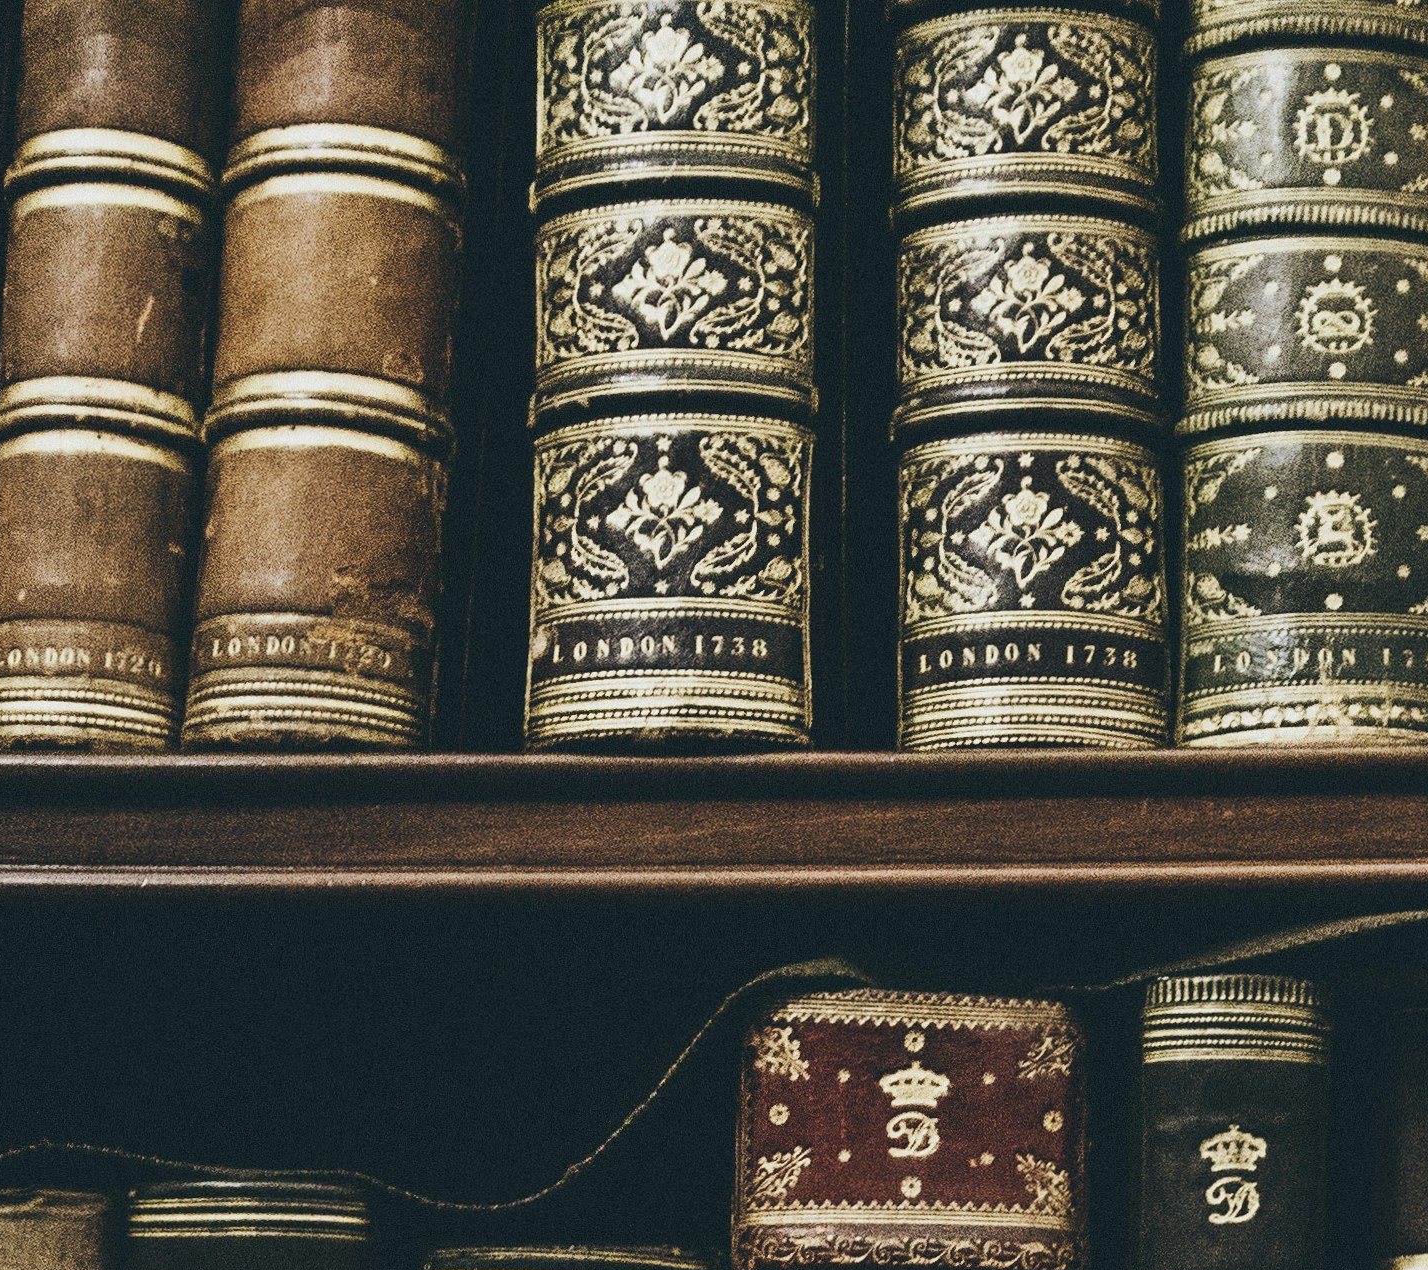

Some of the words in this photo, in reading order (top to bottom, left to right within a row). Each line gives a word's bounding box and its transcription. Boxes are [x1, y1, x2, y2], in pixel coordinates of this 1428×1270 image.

[212, 635, 312, 658] LONDON
[553, 635, 677, 664] LONDON
[695, 633, 769, 660] 1738
[918, 643, 1043, 674] LONDON
[1067, 644, 1138, 670] 1738
